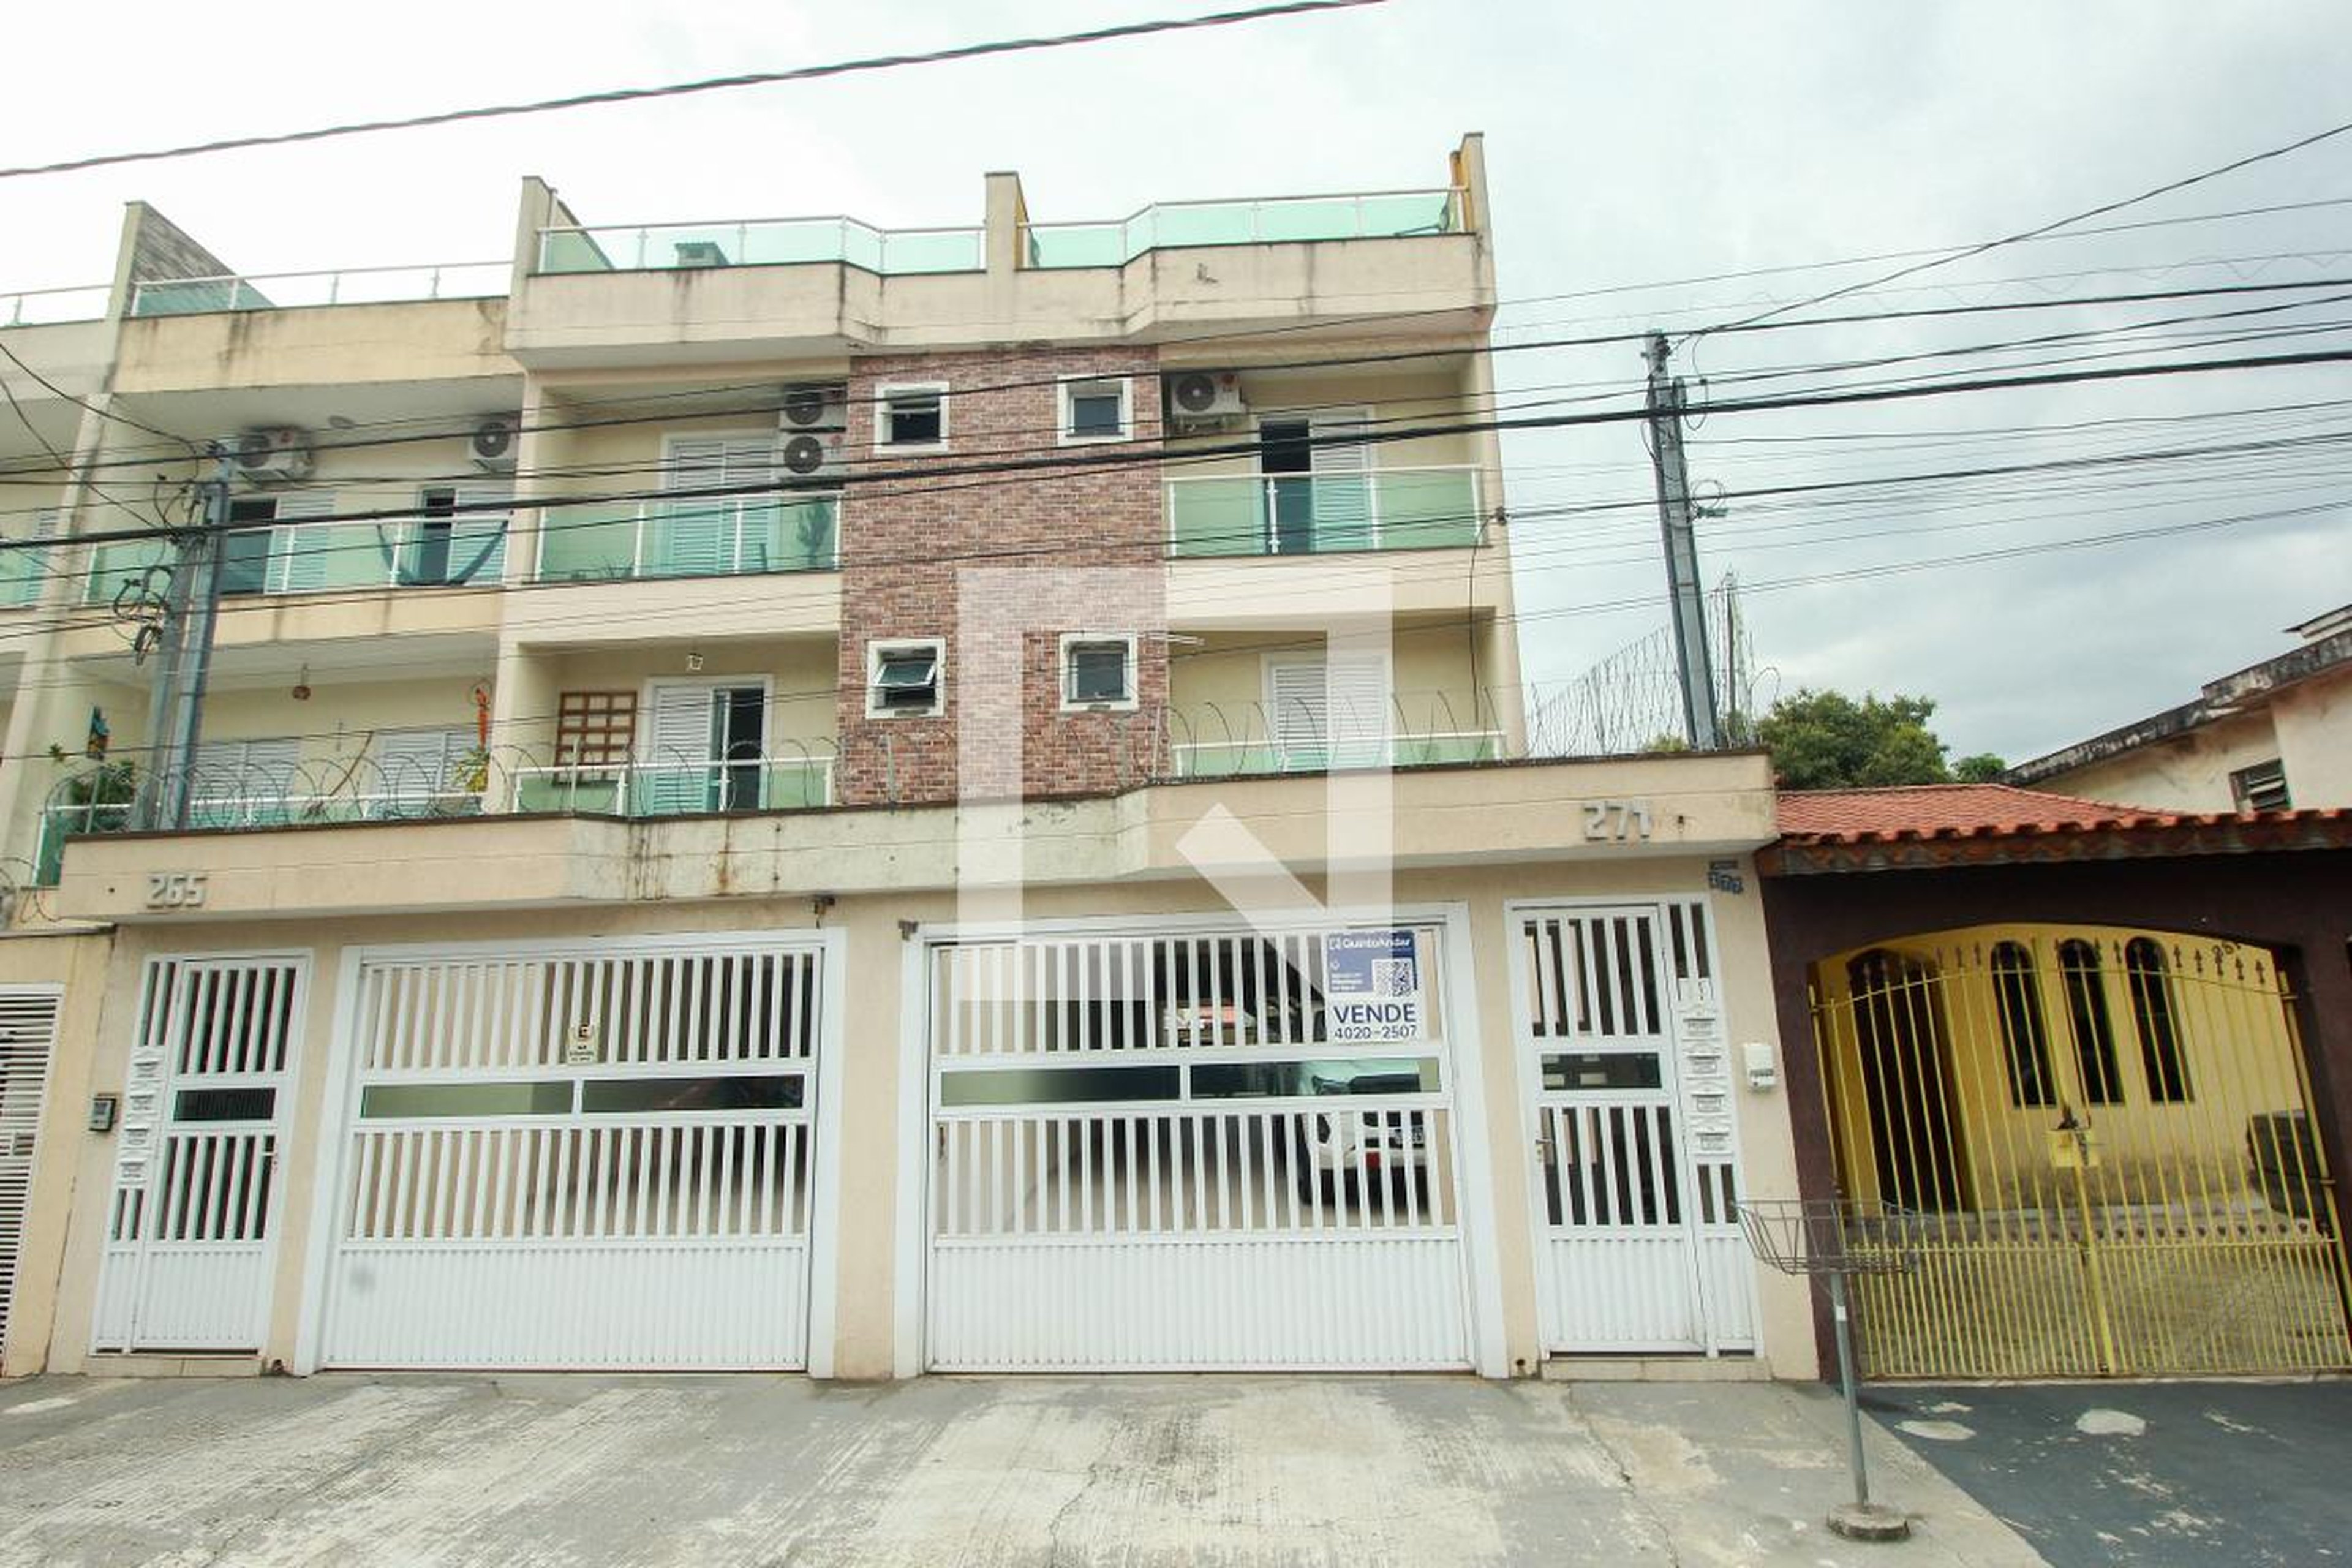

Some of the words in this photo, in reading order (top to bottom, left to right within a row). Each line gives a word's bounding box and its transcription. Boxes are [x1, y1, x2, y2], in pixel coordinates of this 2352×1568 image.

[1583, 799, 1651, 840] 271
[147, 873, 207, 910] 265
[1333, 1003, 1417, 1023] VENDE
[1335, 1024, 1417, 1039] 4020-2507
